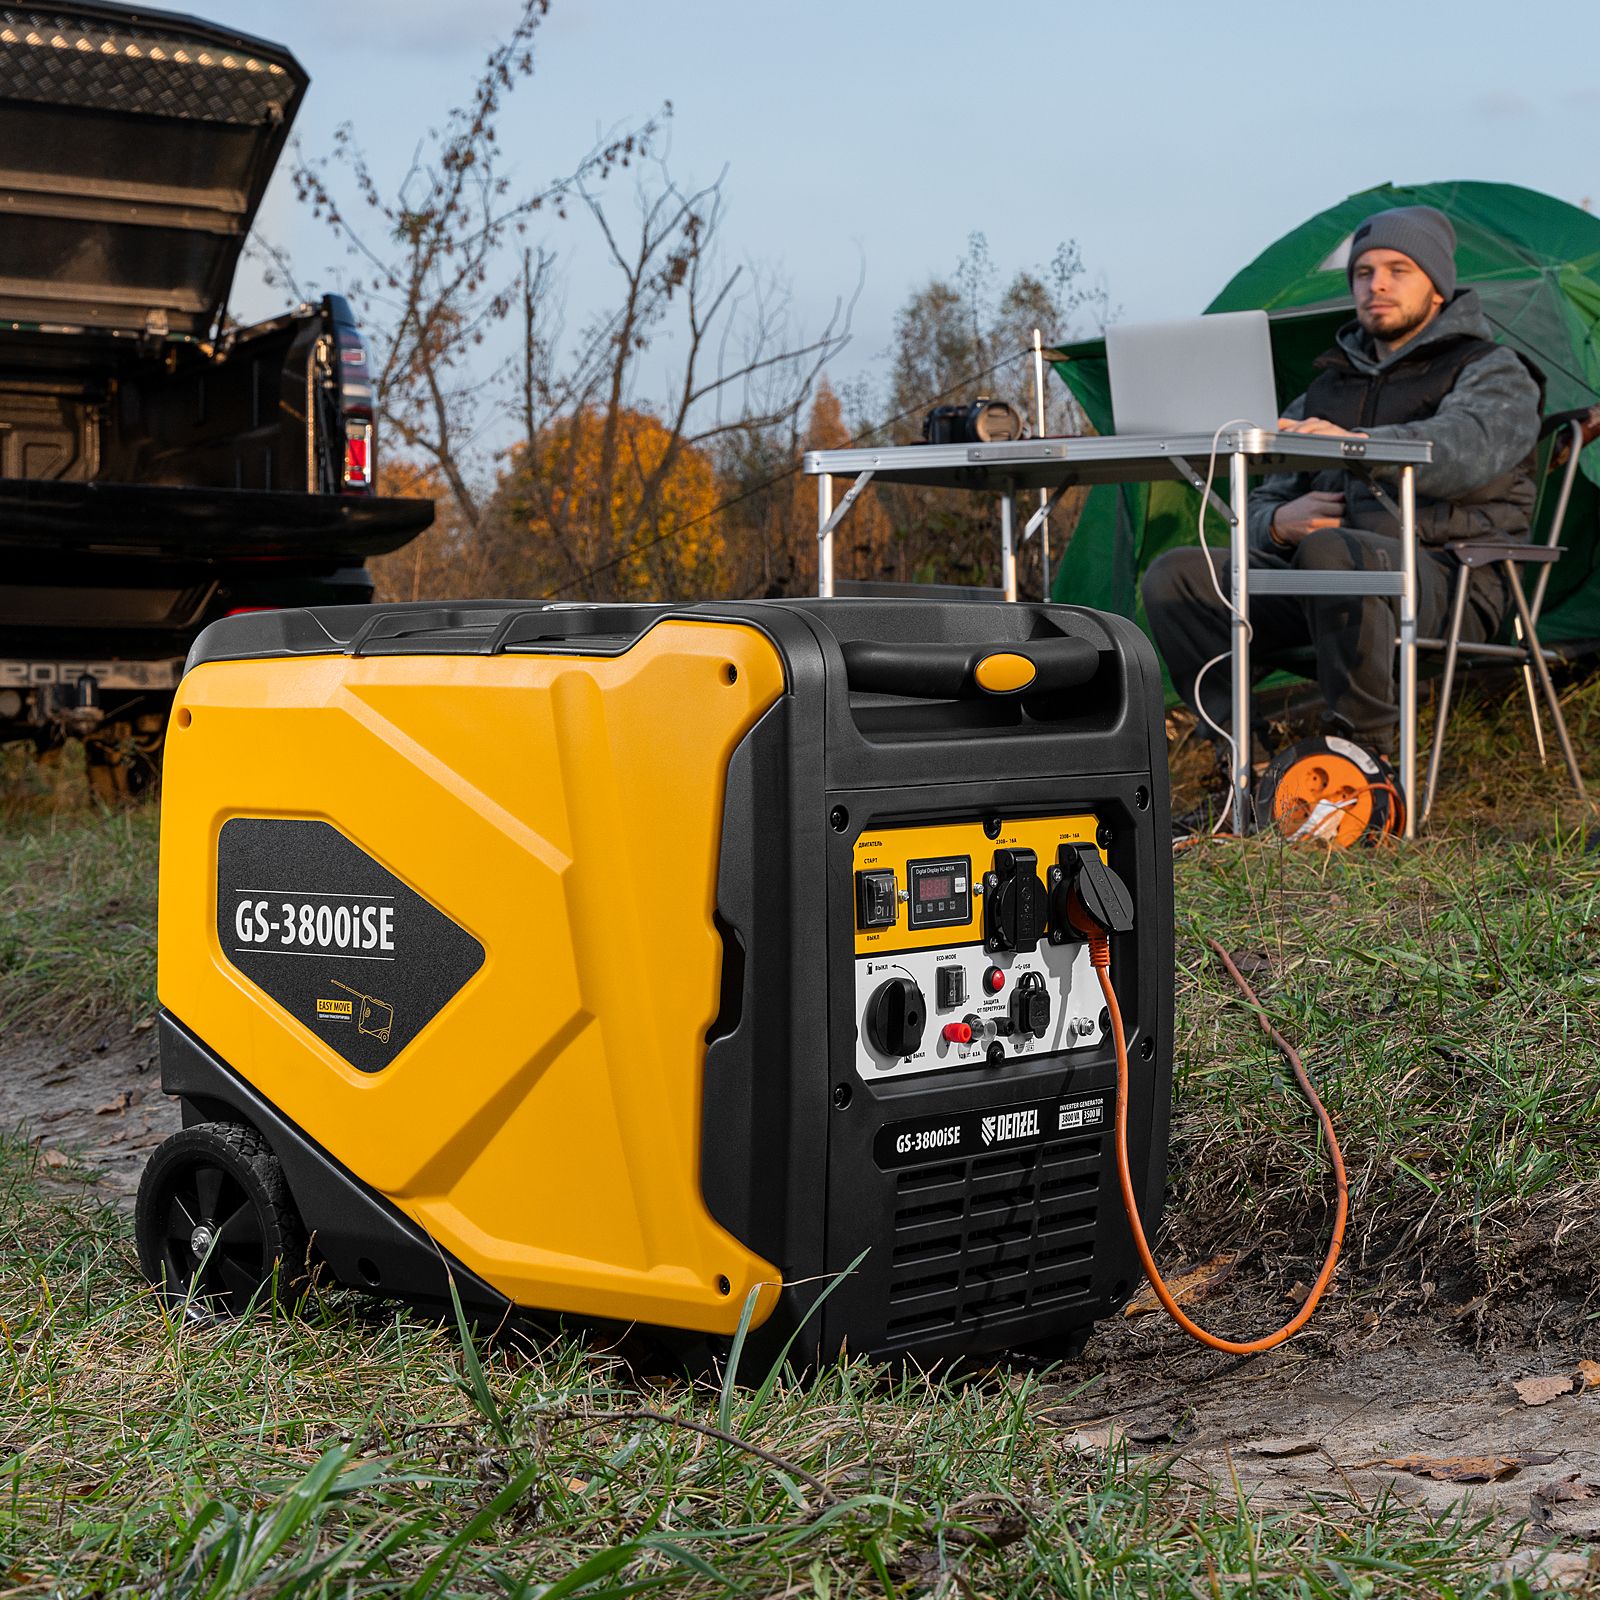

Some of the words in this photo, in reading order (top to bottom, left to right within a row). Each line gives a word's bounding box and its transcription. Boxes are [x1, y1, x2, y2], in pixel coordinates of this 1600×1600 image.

[235, 900, 395, 950] GS-3800iSE
[319, 1001, 332, 1010] EASY
[333, 1002, 351, 1012] MOVE
[1060, 1102, 1080, 1112] INVERTER
[1079, 1097, 1104, 1108] GENERATOR
[1084, 1110, 1095, 1120] 3500
[896, 1126, 961, 1153] GS-3800iSE
[997, 1109, 1040, 1142] DENZEL
